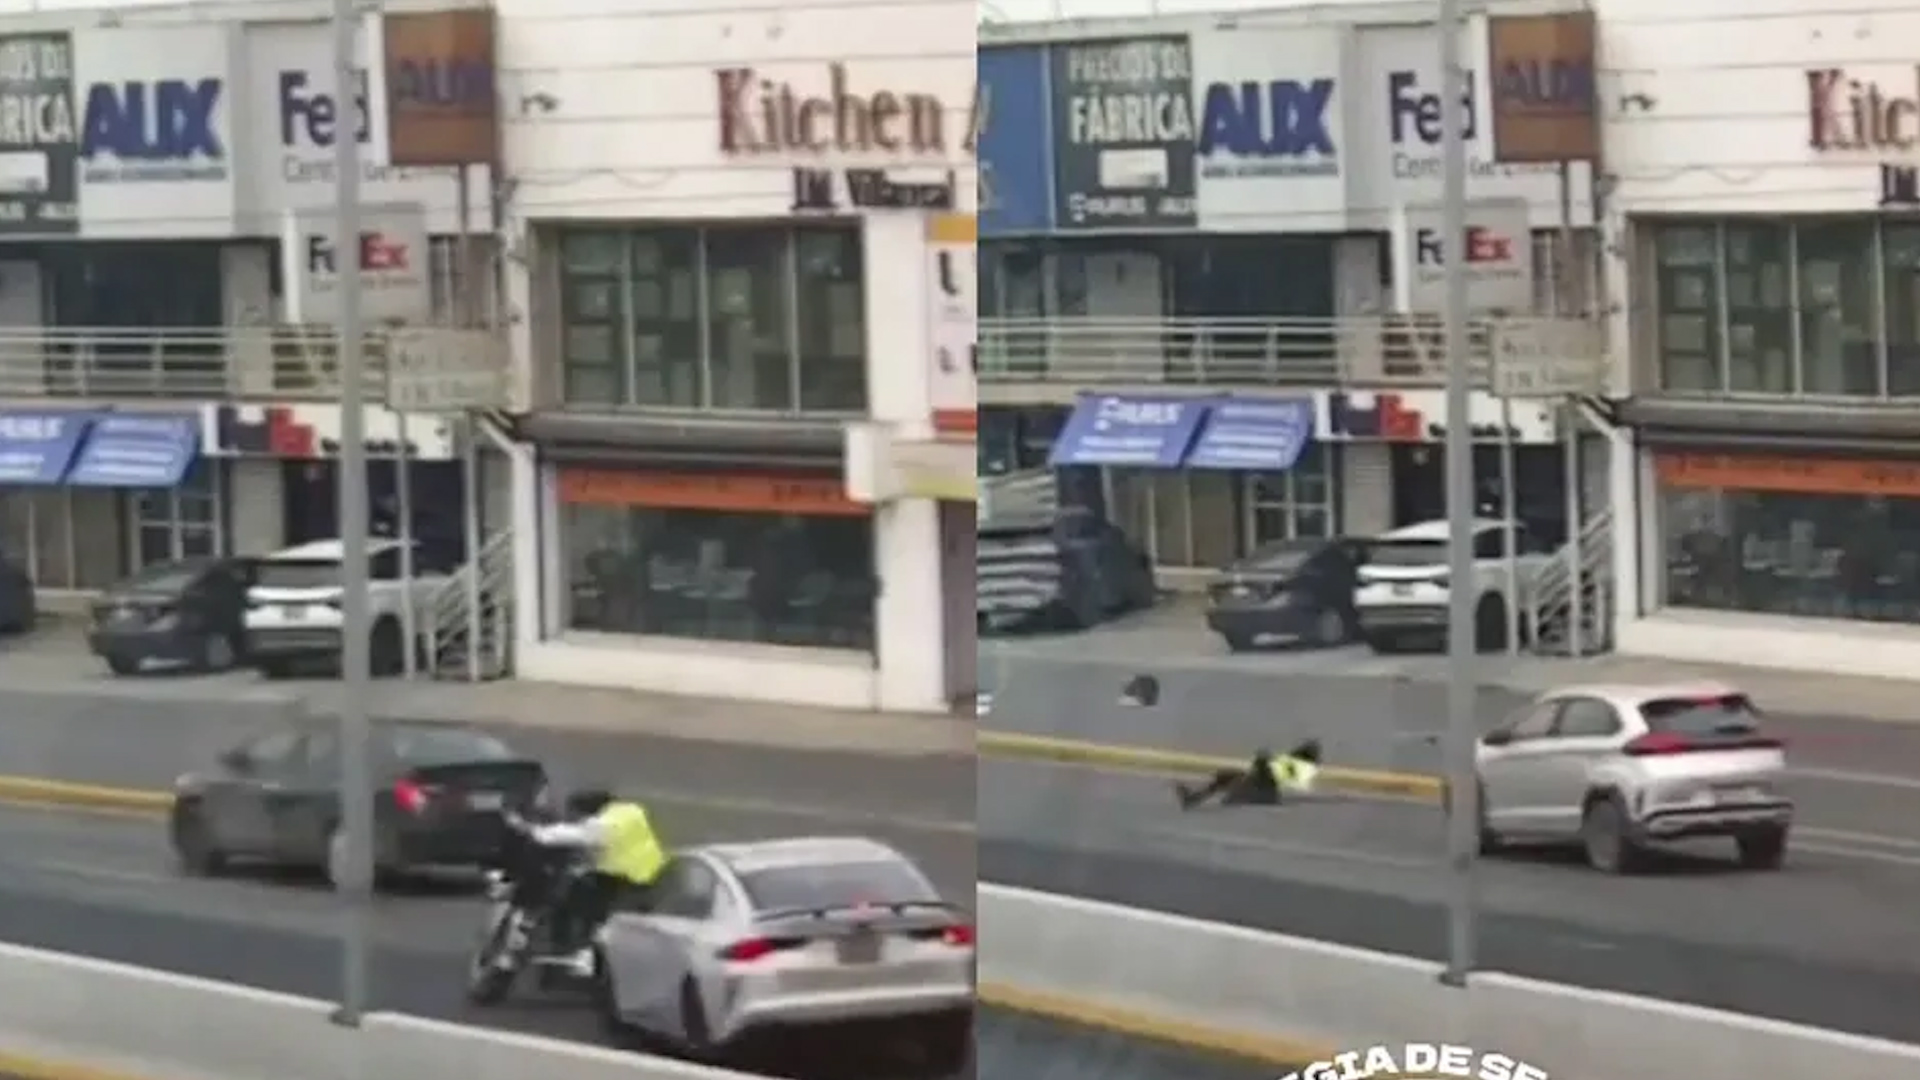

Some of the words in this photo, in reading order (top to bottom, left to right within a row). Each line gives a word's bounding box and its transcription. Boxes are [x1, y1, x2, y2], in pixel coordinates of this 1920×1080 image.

[79, 78, 225, 158] AUX
[713, 62, 946, 154] Kitchen
[1069, 84, 1193, 144] FÁBRICA
[1200, 78, 1337, 156] AUX
[1805, 67, 1920, 152] Kitc
[308, 232, 410, 274] FeEx
[1416, 225, 1511, 265] FeEx
